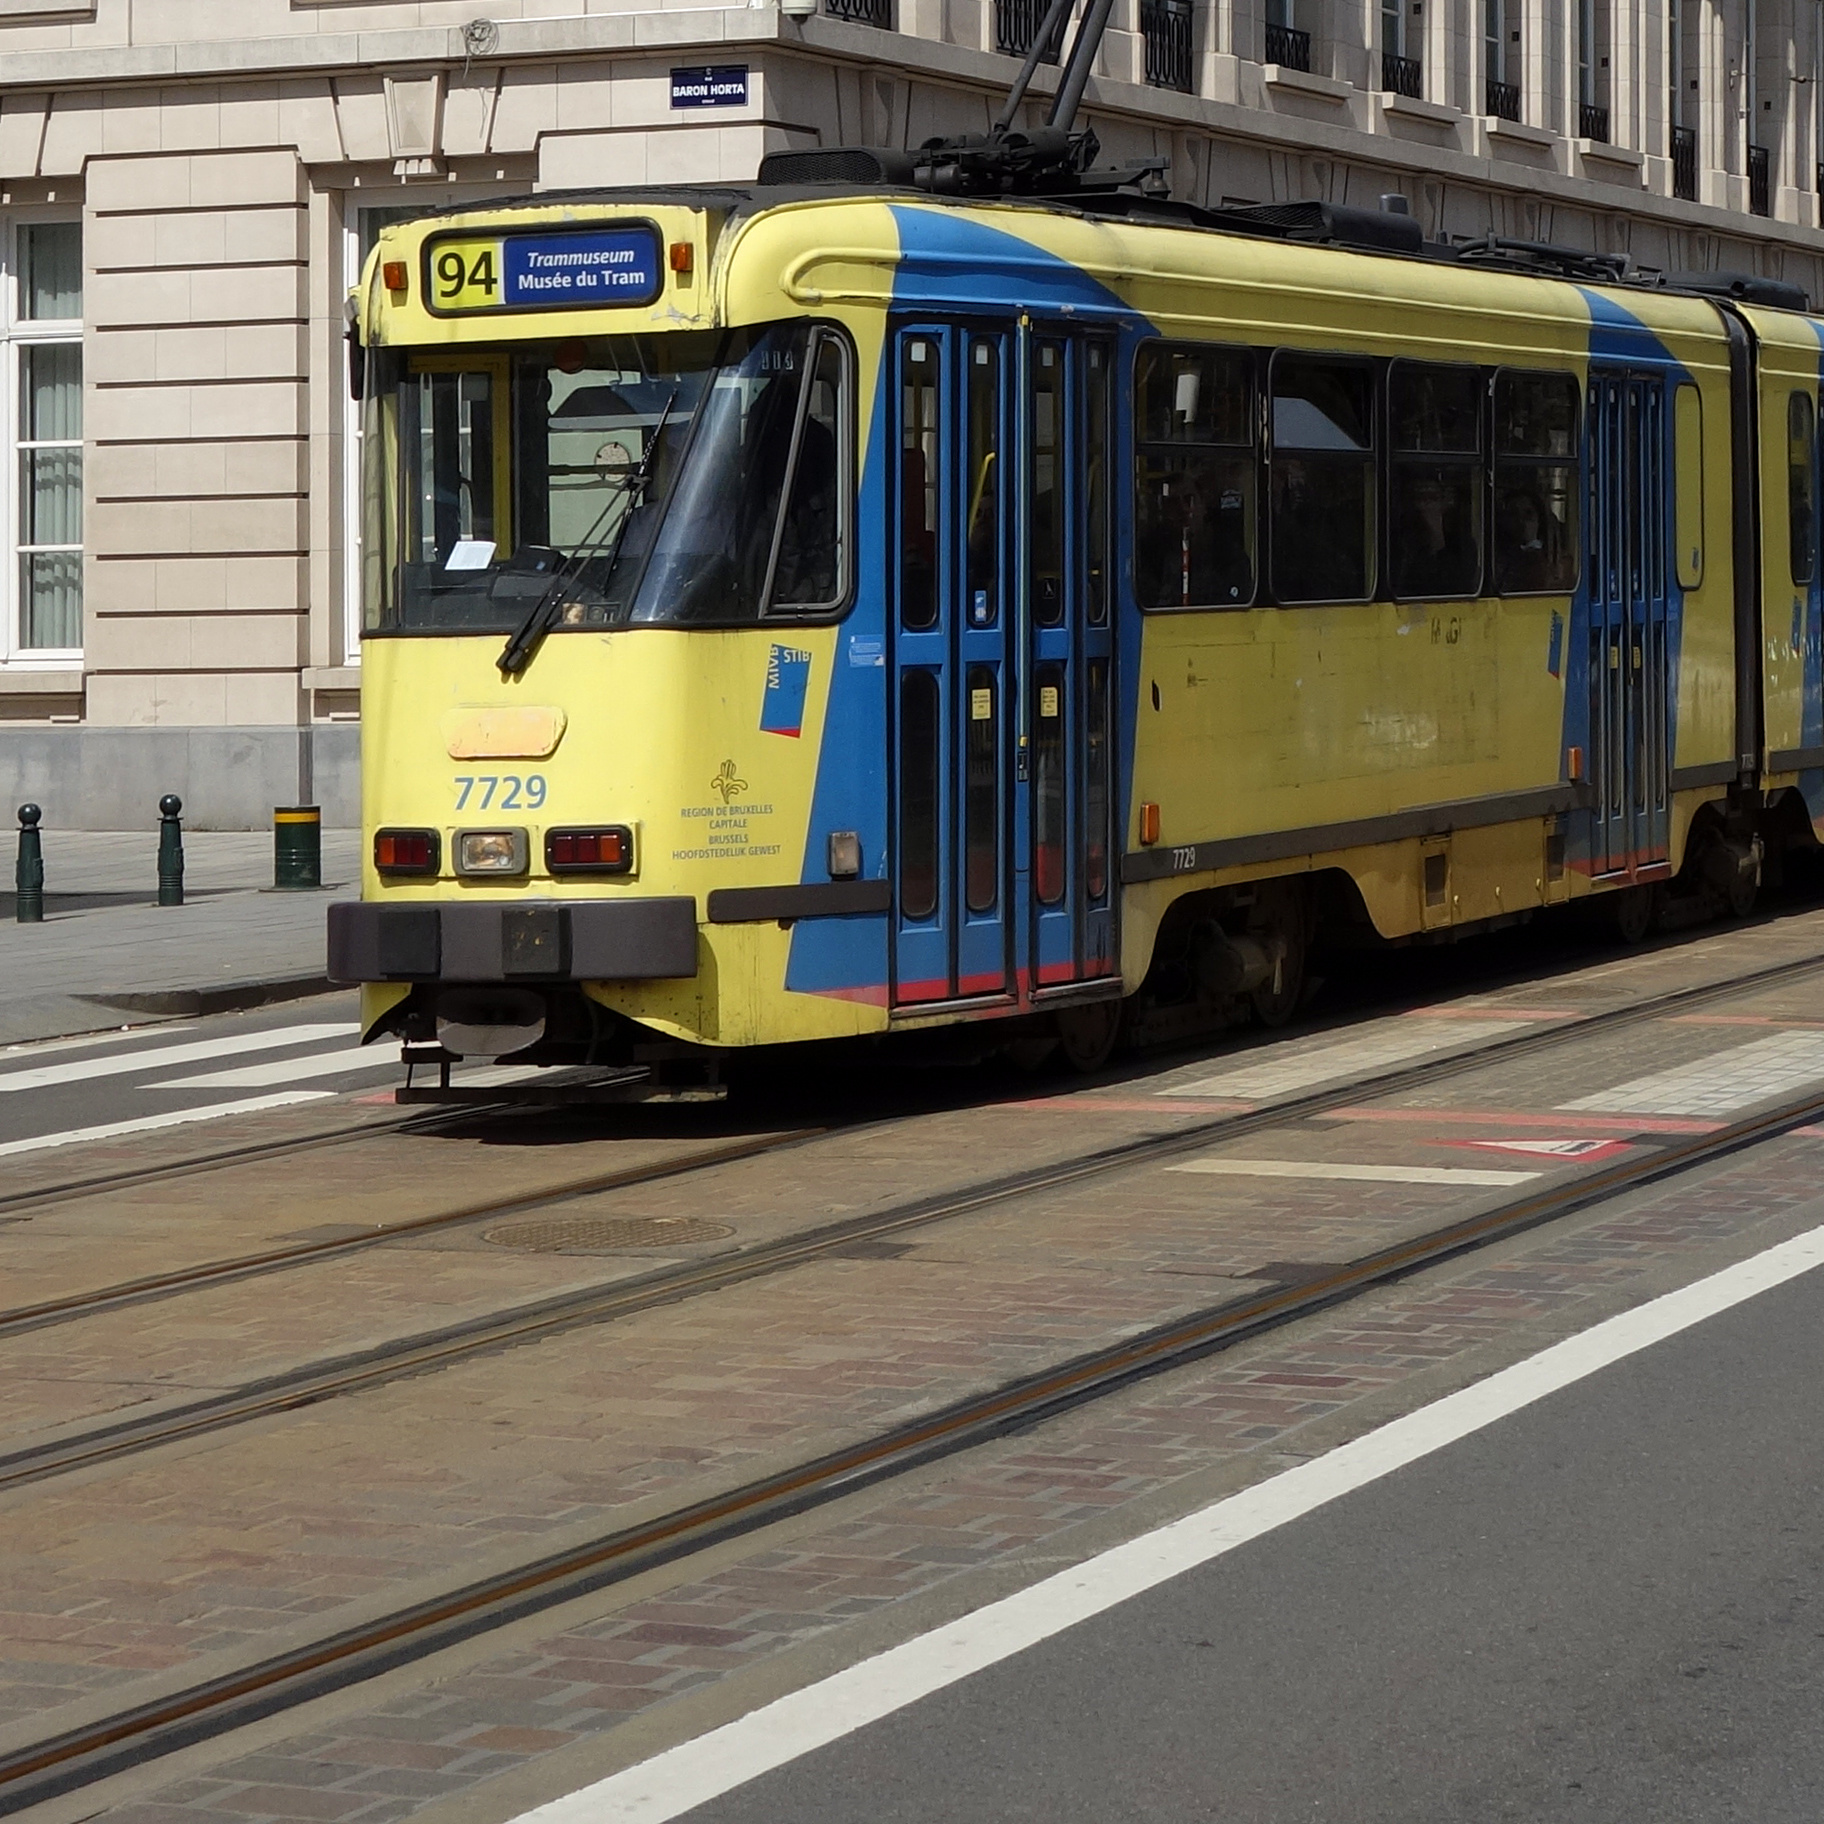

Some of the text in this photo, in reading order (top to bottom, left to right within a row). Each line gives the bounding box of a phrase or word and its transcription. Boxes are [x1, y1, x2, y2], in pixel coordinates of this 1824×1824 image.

[673, 83, 745, 97] BARON HORTA
[528, 250, 635, 268] Trammuseum
[438, 251, 498, 298] 94
[519, 270, 645, 289] Musée du Tram
[783, 649, 810, 663] STIB
[454, 774, 547, 811] 7729
[681, 804, 773, 817] REGION DE BRUXELLES
[709, 819, 747, 829] CAPITALE
[709, 834, 748, 844] BRUSSELS
[672, 845, 781, 860] HOOFDSTEDELIJK GEWEST
[1173, 846, 1196, 870] 7729
